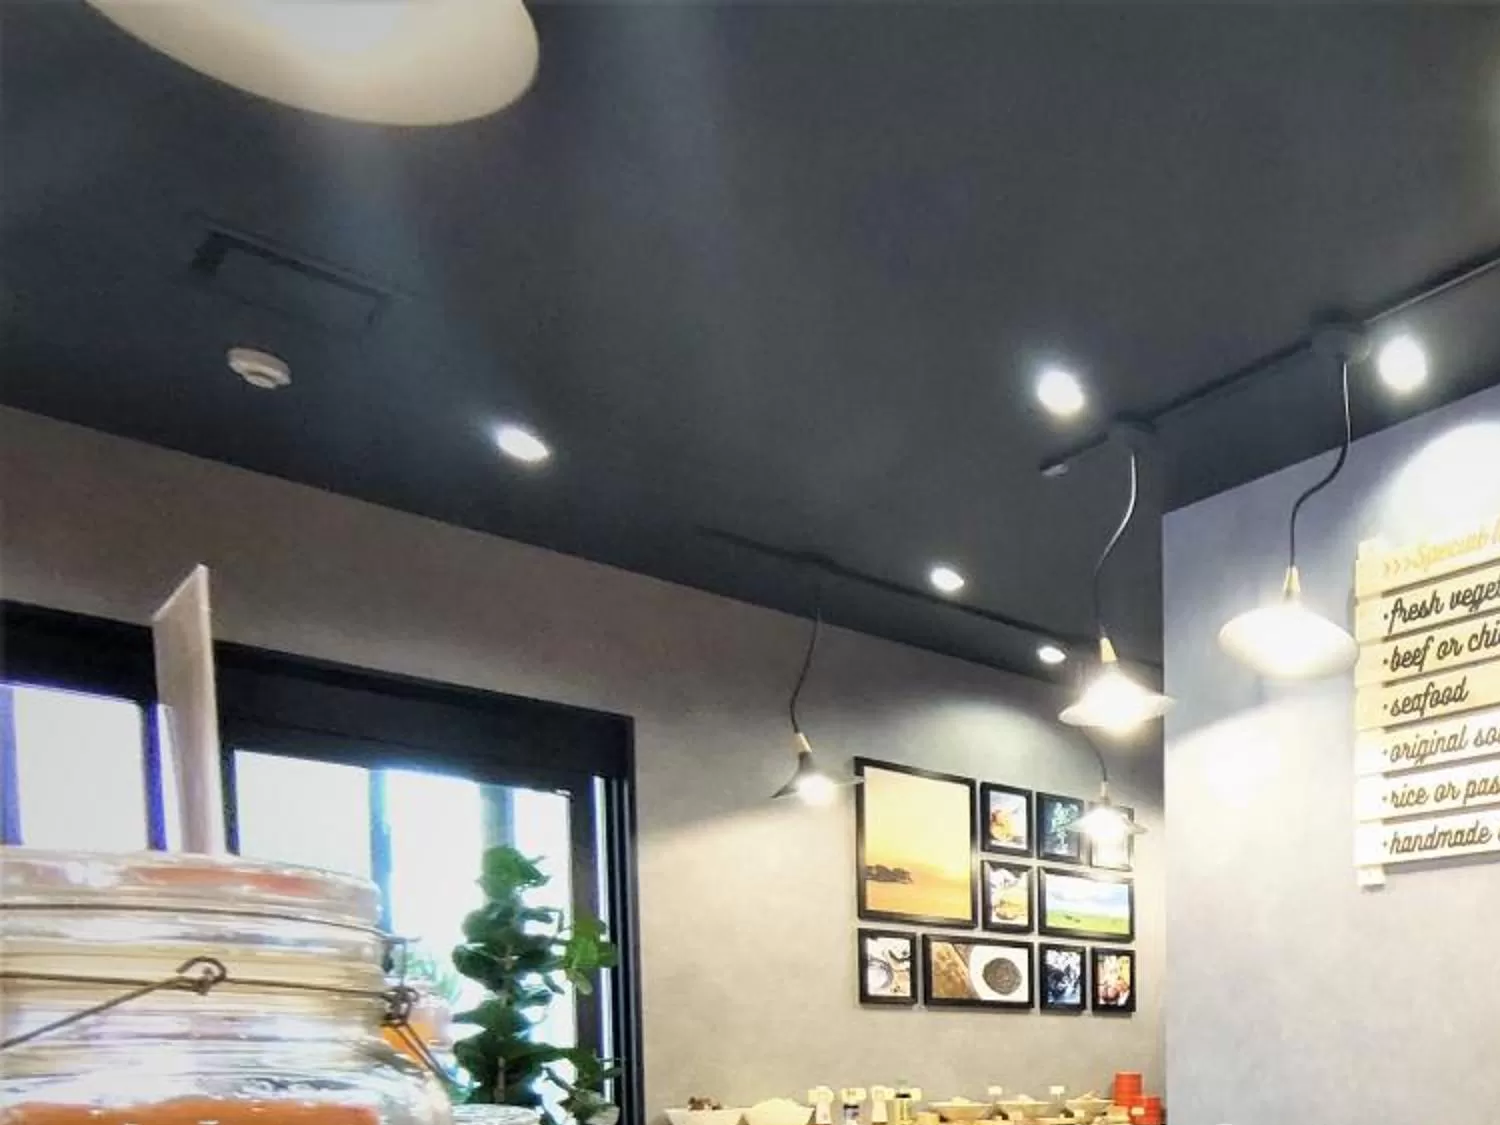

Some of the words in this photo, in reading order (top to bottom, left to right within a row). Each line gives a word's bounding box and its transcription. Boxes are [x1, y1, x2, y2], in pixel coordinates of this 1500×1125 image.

[1388, 592, 1444, 634] fresh
[1389, 635, 1434, 674] beef
[1435, 640, 1463, 663] or
[1389, 675, 1470, 718] seafood
[1389, 723, 1469, 767] original
[1390, 786, 1430, 810] rice
[1433, 780, 1460, 800] or
[1388, 824, 1493, 855] handmade
